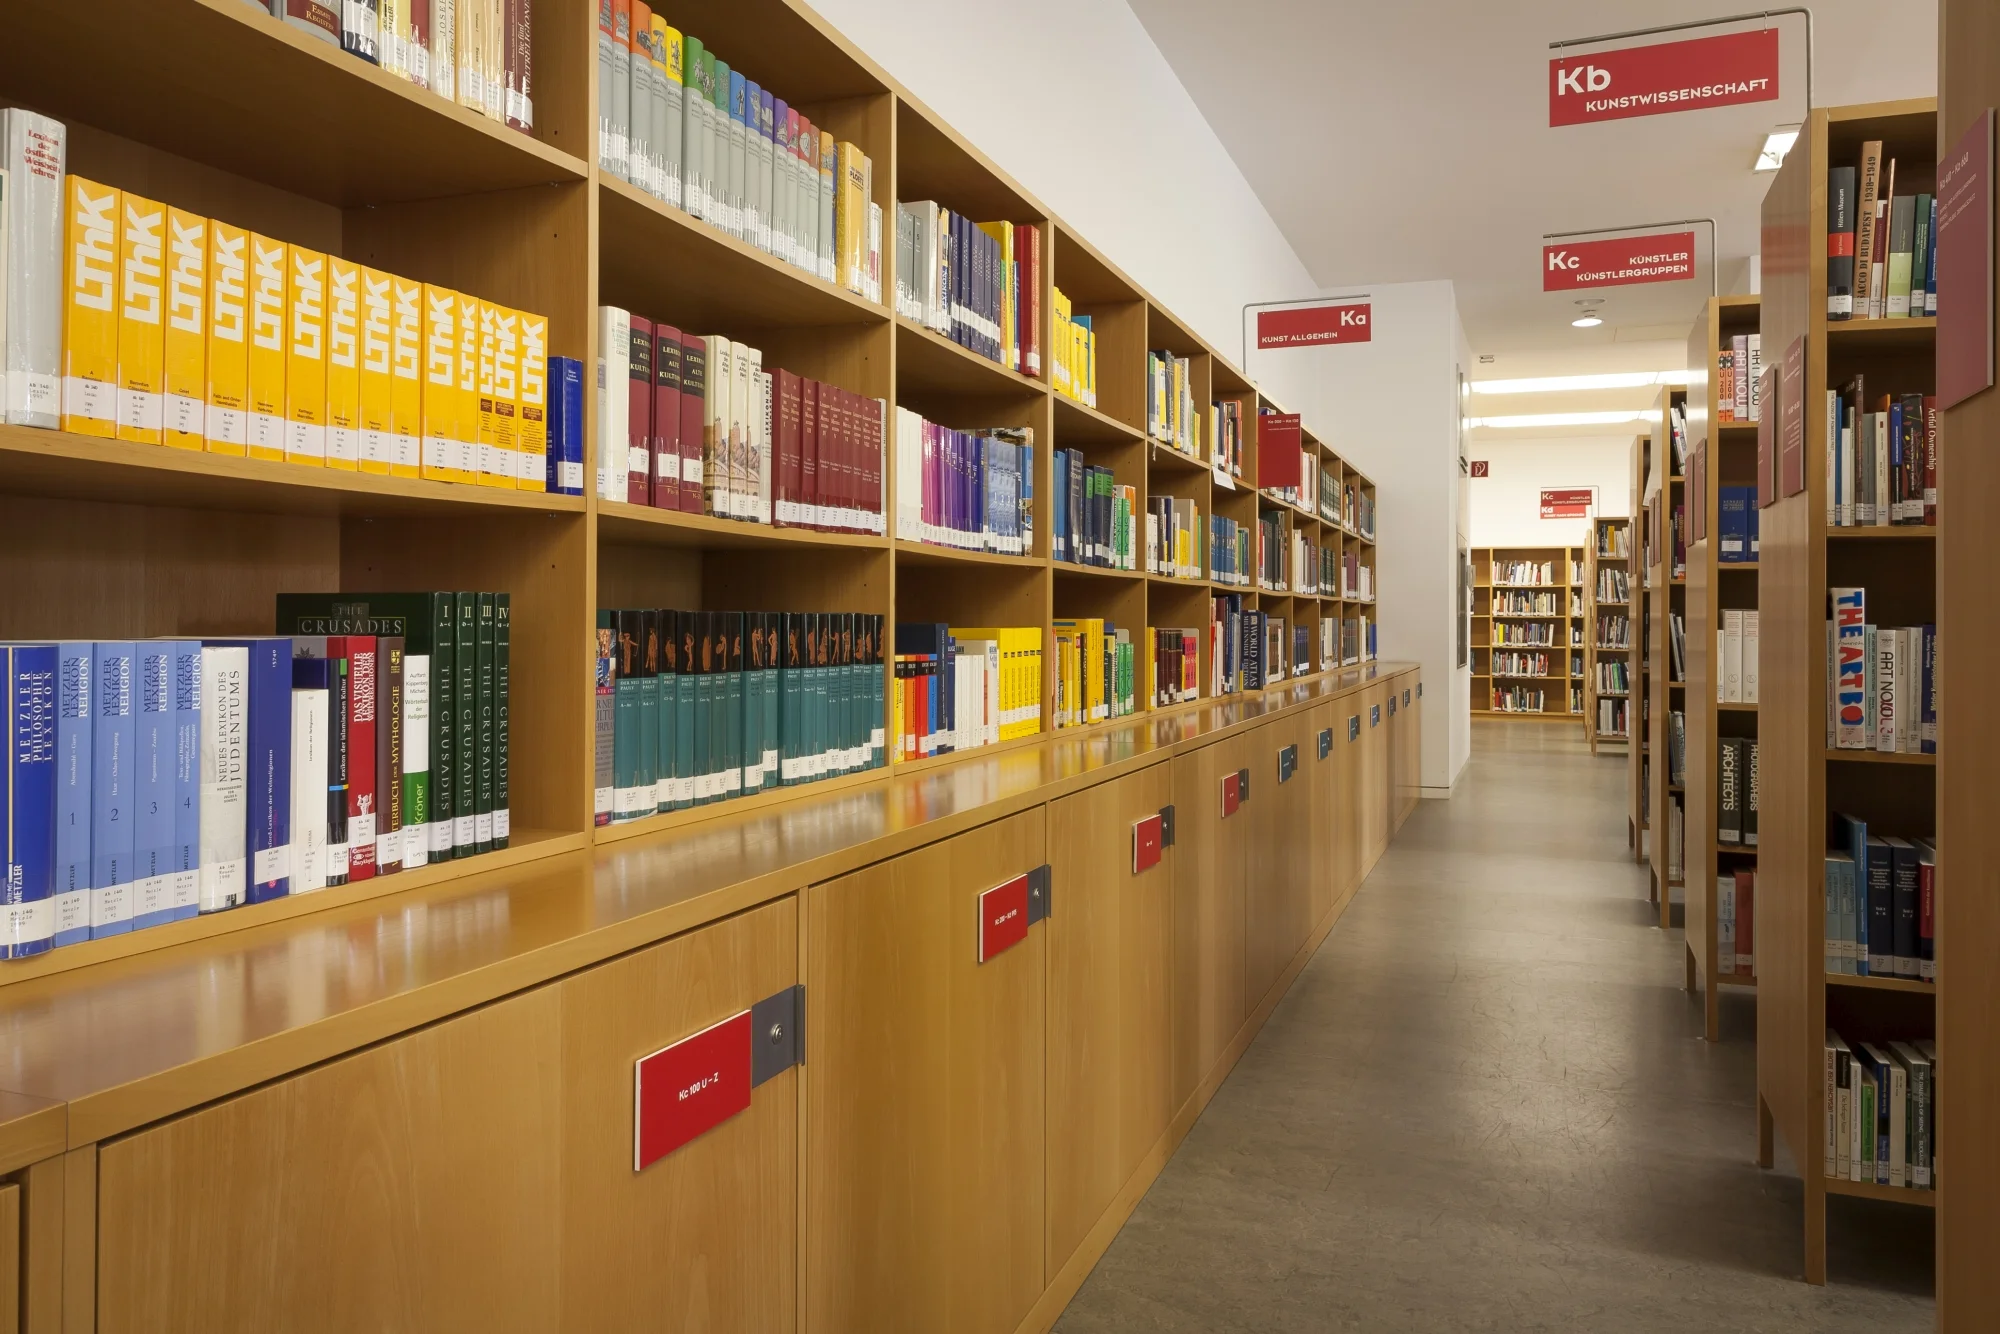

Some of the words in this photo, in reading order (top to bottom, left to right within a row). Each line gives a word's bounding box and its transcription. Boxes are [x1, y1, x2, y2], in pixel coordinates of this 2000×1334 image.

[1558, 65, 1611, 96] Kb
[1586, 78, 1768, 112] KUNSTWISSENSCHAFT
[28, 129, 59, 146] Lexikon
[1864, 156, 1876, 202] 1938–1949
[1860, 211, 1872, 257] BUDAPEST
[1549, 251, 1580, 271] Kc
[1576, 264, 1688, 282] KÜNSTLERGRUPPEN
[1629, 252, 1688, 265] KÜNSTLER
[1860, 259, 1868, 269] DI
[1340, 310, 1366, 326] Ka
[1261, 335, 1288, 343] KUNST
[1290, 332, 1338, 341] ALLGEMEIN
[1736, 350, 1747, 374] ART
[1736, 376, 1748, 408] NOW
[1928, 408, 1937, 428] Artful
[1928, 428, 1937, 470] Ownership
[301, 619, 402, 634] CRUSADES
[444, 606, 448, 618] I
[464, 606, 472, 618] II
[482, 606, 492, 617] III
[498, 608, 510, 619] IV
[1838, 591, 1863, 639] THE
[1250, 625, 1258, 658] WORLD
[184, 654, 192, 710] LEXIKON
[192, 654, 201, 710] RELIGION
[354, 653, 363, 700] VISUELLE
[362, 652, 370, 674] DER
[482, 664, 490, 698] THE
[500, 664, 508, 698] THE
[1250, 660, 1258, 687] ATLAS
[1839, 647, 1864, 689] ART
[1880, 652, 1894, 678] ART
[62, 658, 71, 718] METZLER
[70, 657, 80, 718] LEXIKON
[79, 656, 89, 718] RELIGION
[103, 659, 112, 716] METZLER
[112, 658, 120, 716] LEXIKON
[120, 656, 130, 716] RELIGION
[144, 656, 152, 712] METZLER
[152, 655, 160, 712] LEXIKON
[159, 654, 168, 712] RELIGION
[176, 656, 185, 710] METZLER
[218, 672, 227, 693] DES
[362, 677, 370, 722] LEXIKON
[441, 666, 450, 702] THE
[464, 666, 472, 700] THE
[20, 672, 31, 763] METZLER
[32, 673, 43, 762] PHILOSOPHIE
[44, 672, 52, 761] LEXIKON
[218, 696, 227, 744] LEXIKON
[229, 670, 242, 783] JUDENTUMS
[354, 702, 363, 722] DAS
[392, 686, 400, 764] MYTHOLOGIE
[218, 747, 228, 783] NEUES
[441, 711, 450, 810] CRUSADES
[464, 709, 472, 807] CRUSADES
[482, 706, 490, 800] CRUSADES
[500, 706, 508, 799] CRUSADES
[1722, 744, 1734, 811] ARCHITECTS
[1750, 744, 1758, 812] PHOTOGRAPHERS
[70, 812, 76, 825] 1
[110, 808, 118, 822] 2
[150, 801, 158, 814] 3
[184, 796, 191, 808] 4
[414, 784, 424, 824] Kröner
[14, 864, 22, 904] METZLER
[679, 1089, 689, 1101] Kc
[690, 1082, 701, 1096] 100
[702, 1078, 707, 1089] U
[714, 1072, 719, 1083] Z
